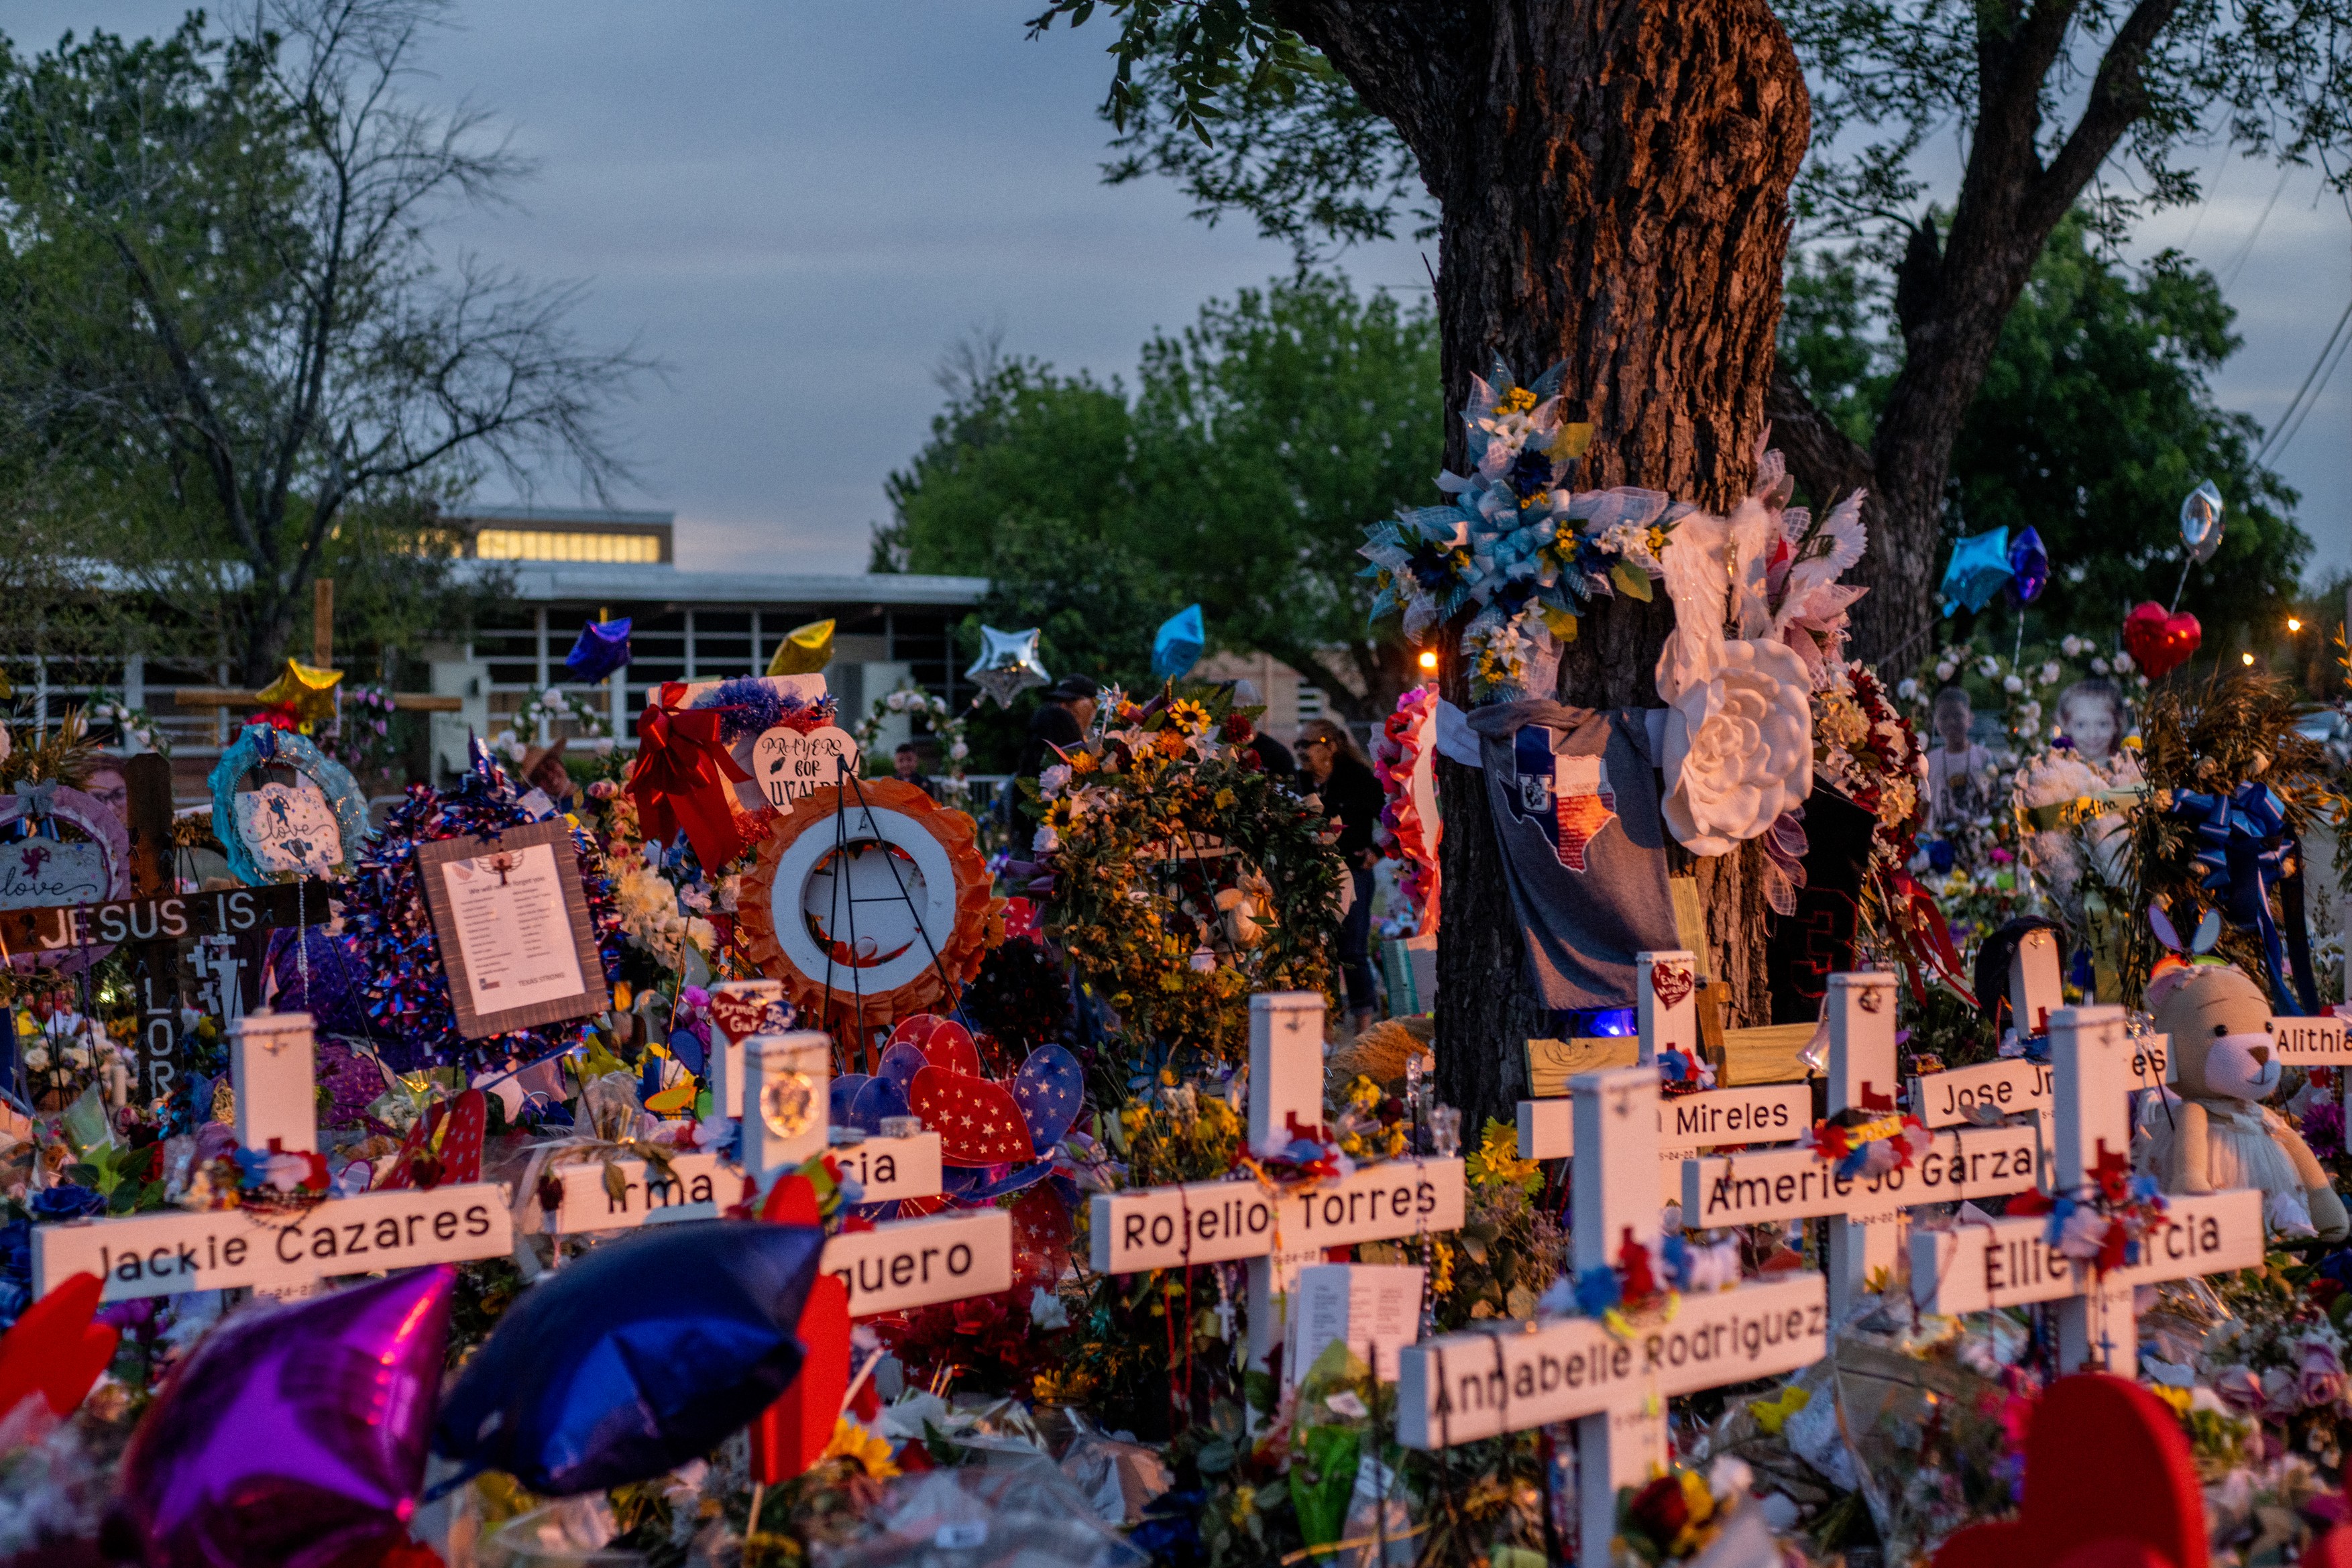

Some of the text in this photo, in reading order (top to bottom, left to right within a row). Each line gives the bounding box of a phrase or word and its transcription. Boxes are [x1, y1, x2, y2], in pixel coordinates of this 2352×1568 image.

[762, 737, 842, 760] PRAYERS
[770, 780, 843, 806] UVAL
[247, 811, 334, 844] love
[0, 866, 98, 897] love
[40, 891, 256, 949] JESUS IS
[517, 972, 565, 987] TEXAS STRONG
[144, 976, 175, 1099] LOR
[1942, 1080, 2013, 1115] Jose
[1677, 1103, 1789, 1135] Mireles
[1658, 1150, 1695, 1161] 5-24-22
[1707, 1162, 1852, 1215] Amerie
[1921, 1147, 2032, 1186] Garza
[1124, 1180, 1437, 1258] Rojelio Torres
[1852, 1213, 1894, 1227] 5-24-22
[99, 1205, 491, 1282] Jackie Cazares
[1984, 1236, 2068, 1292] Ellie
[1434, 1302, 1825, 1414] Annabelle Rodriguez
